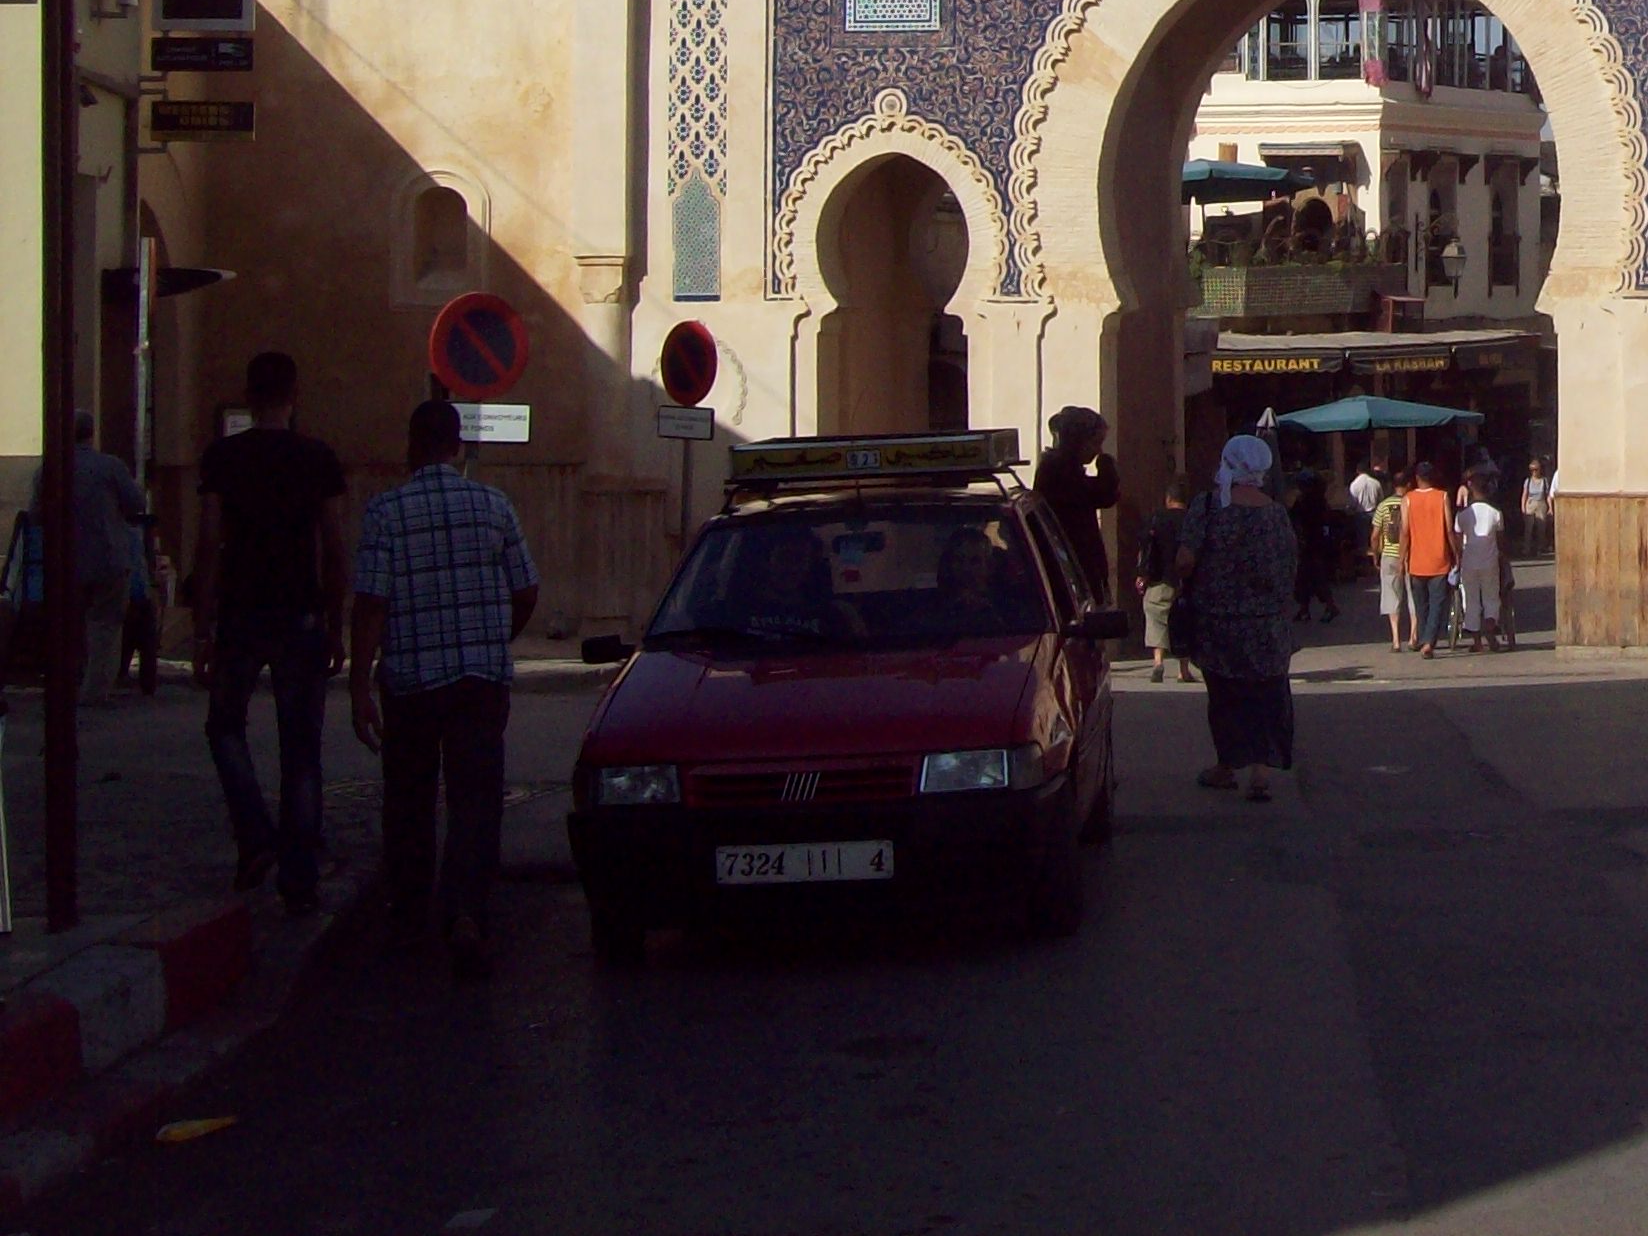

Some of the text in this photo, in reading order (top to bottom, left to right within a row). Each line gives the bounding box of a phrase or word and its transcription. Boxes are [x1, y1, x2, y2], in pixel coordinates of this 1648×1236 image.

[1212, 358, 1320, 372] RESTAURANT
[725, 851, 785, 877] 7324
[870, 848, 885, 872] 4
